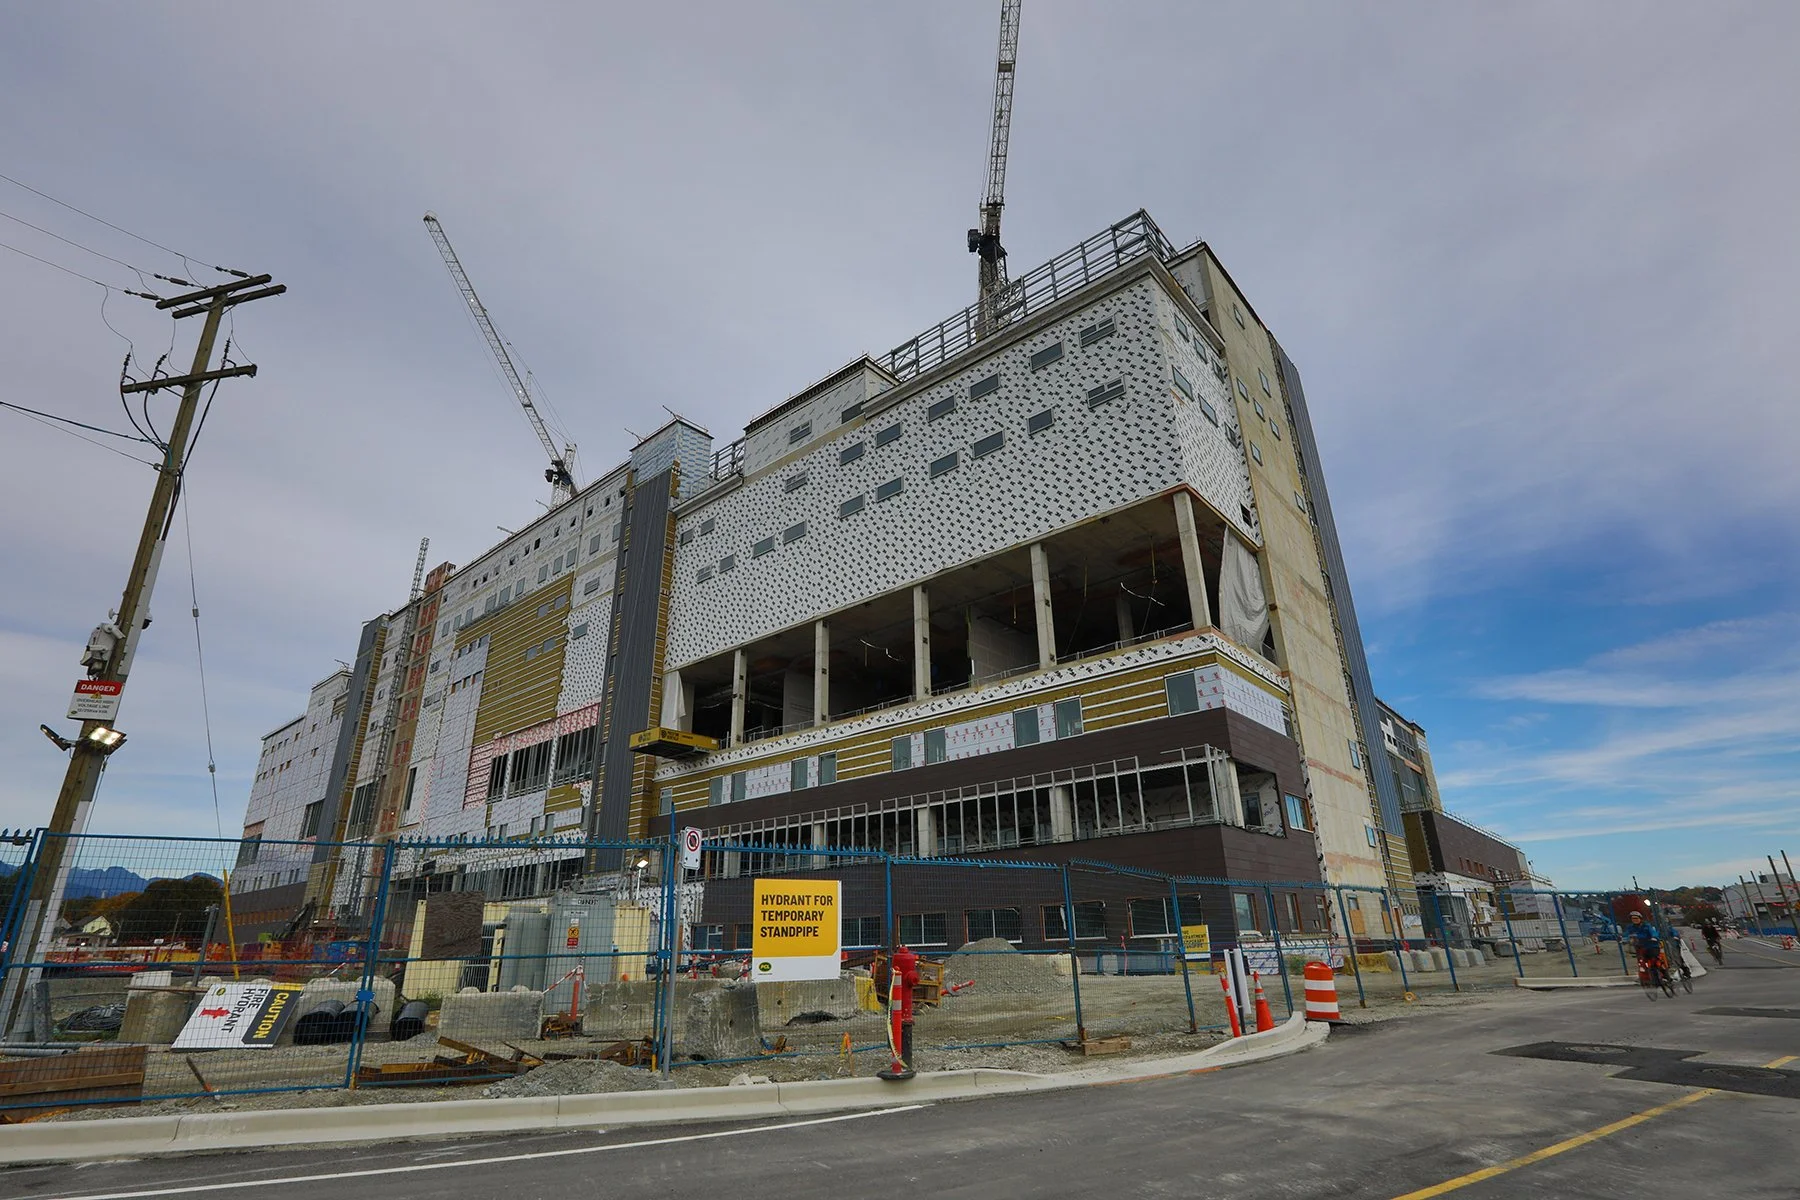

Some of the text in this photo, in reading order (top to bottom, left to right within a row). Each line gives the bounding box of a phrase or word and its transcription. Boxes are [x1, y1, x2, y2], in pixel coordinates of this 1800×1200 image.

[81, 684, 115, 692] DANGER
[761, 894, 833, 906] HYDRANT FOR
[761, 910, 824, 921] TEMPORARY
[760, 926, 819, 938] STANDPIPE
[248, 988, 269, 1009] FIRE
[221, 988, 253, 1033] HYDRANT
[252, 992, 290, 1039] CAUTION
